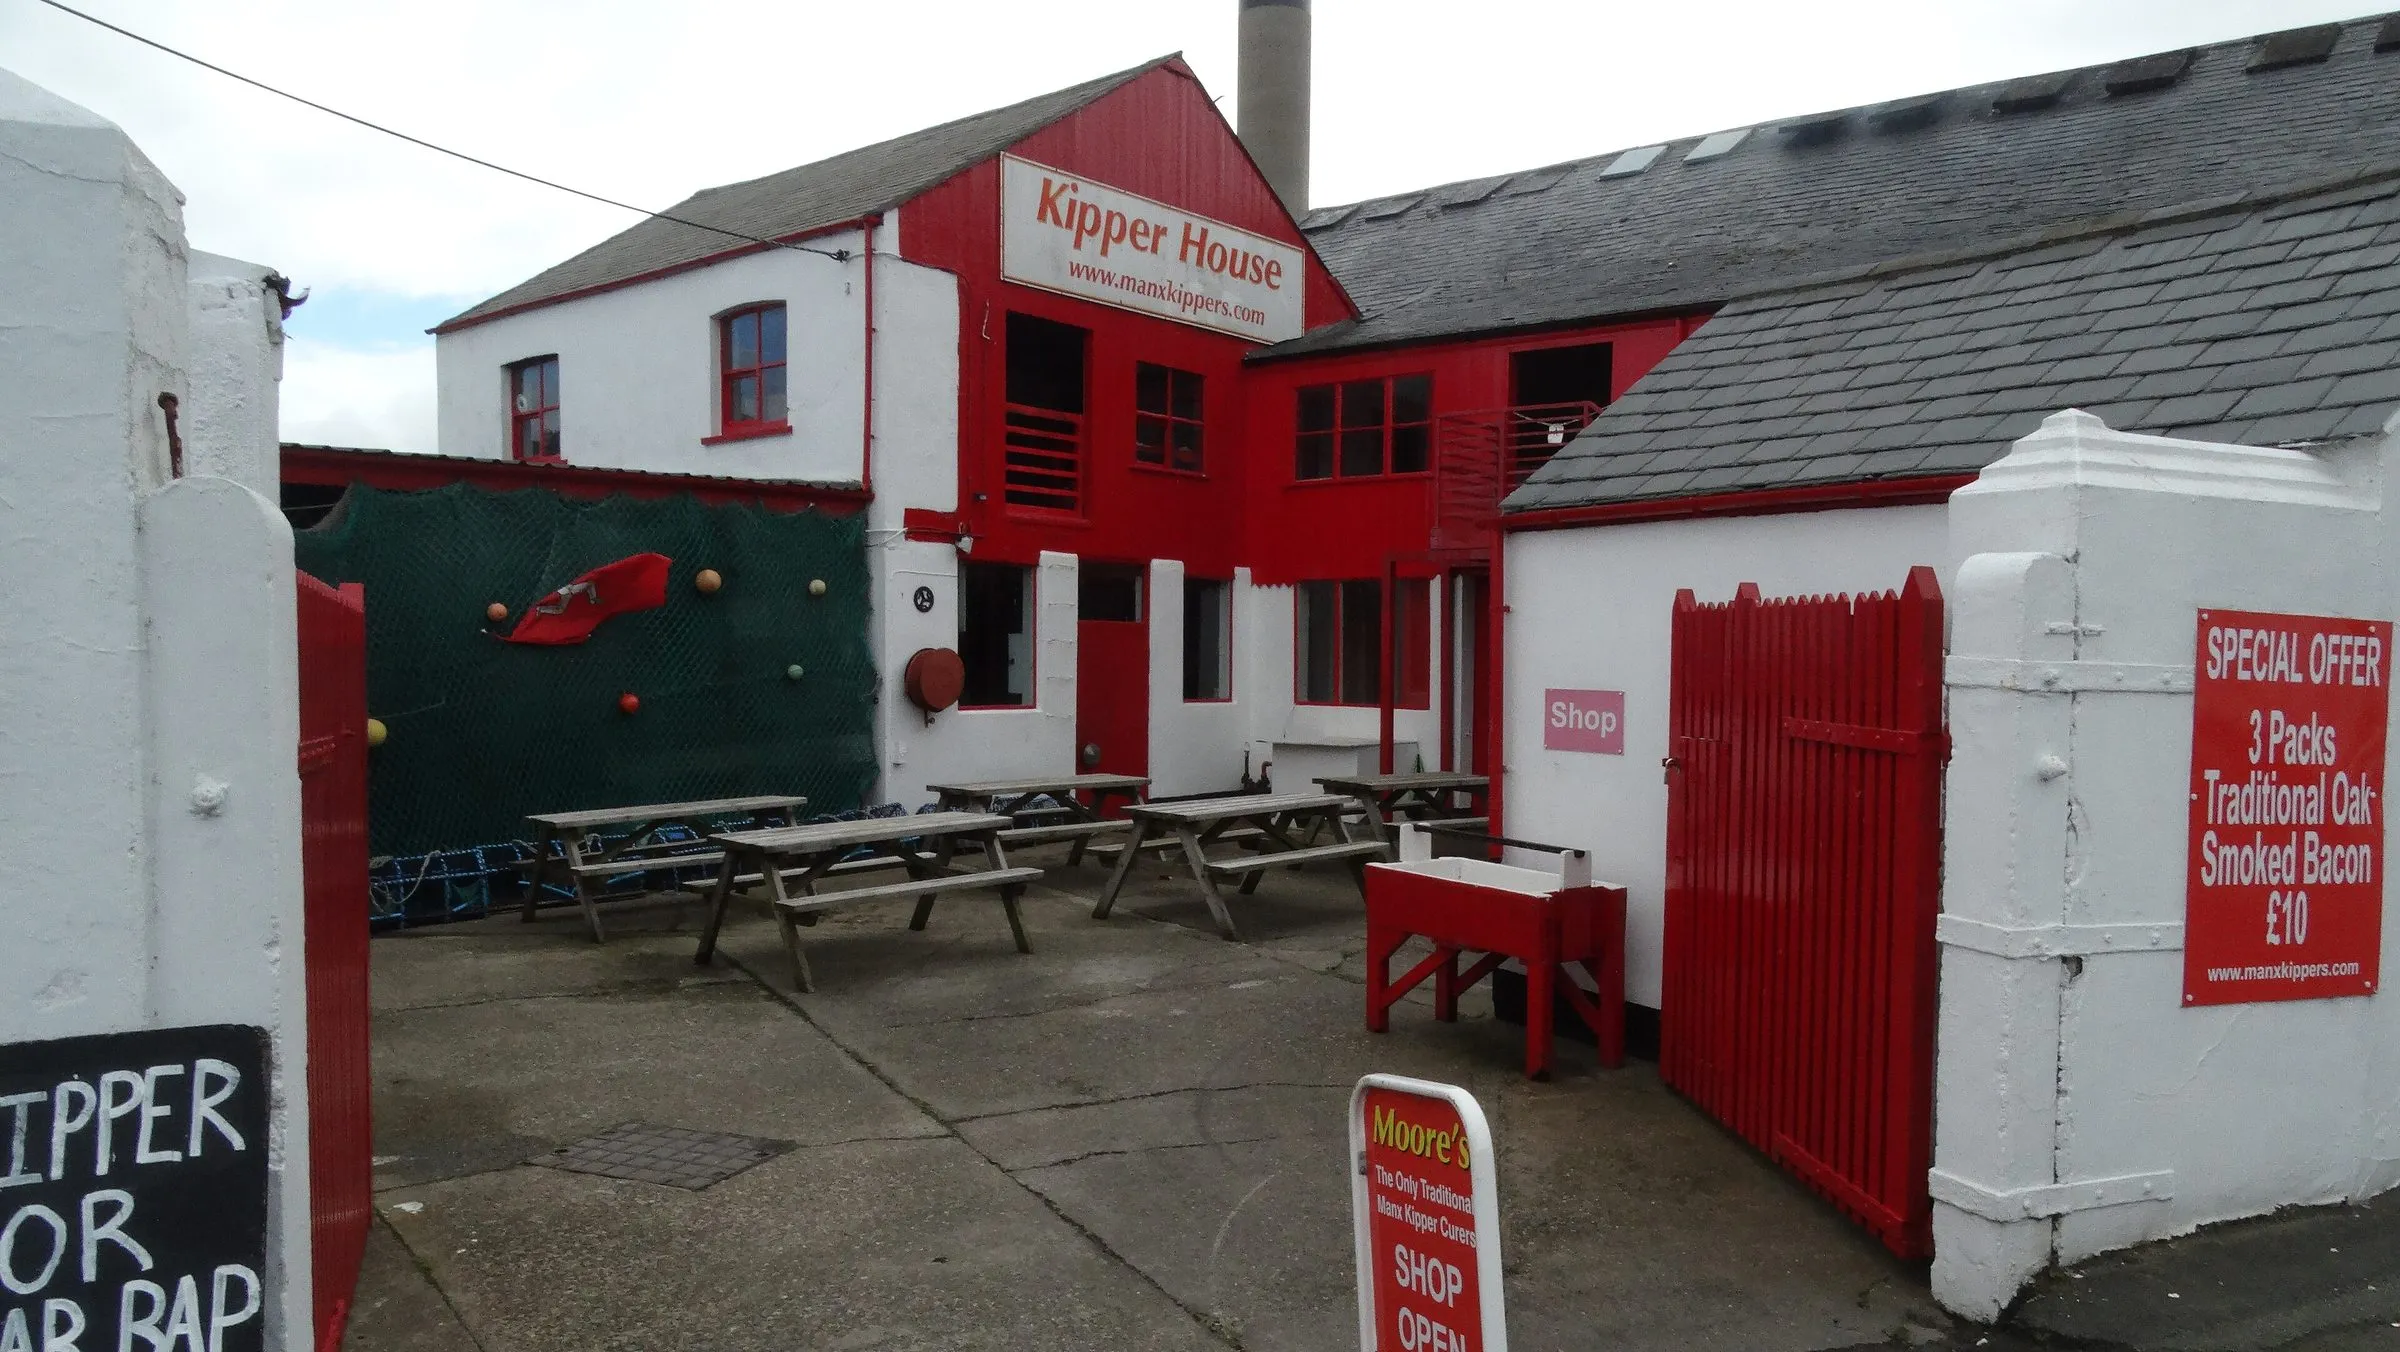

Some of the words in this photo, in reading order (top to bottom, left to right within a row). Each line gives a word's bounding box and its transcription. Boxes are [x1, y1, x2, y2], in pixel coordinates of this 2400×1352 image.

[1036, 177, 1167, 257] Kipper
[1178, 220, 1283, 291] House
[1068, 260, 1266, 326] www.manxkippers.com
[2206, 626, 2303, 683] SPECIAL
[2309, 632, 2381, 688] OFFER
[1551, 701, 1617, 738] Shop
[2248, 708, 2262, 765] 3
[2269, 710, 2336, 767] Packs
[2204, 769, 2325, 826] Traditional
[2332, 772, 2373, 826] Oak
[2201, 829, 2296, 887] Smoked
[2303, 830, 2371, 885] Bacon
[2266, 890, 2308, 946] £10
[2207, 960, 2360, 983] www.manxkippers.com
[1373, 1104, 1470, 1169] Moore's
[1375, 1164, 1394, 1188] The
[1395, 1170, 1418, 1200] Only
[1377, 1194, 1402, 1221] Manx
[1404, 1203, 1437, 1234] Kipper
[1440, 1215, 1476, 1248] Curers
[1395, 1243, 1463, 1308] SHOP
[1398, 1306, 1466, 1352] OPEN
